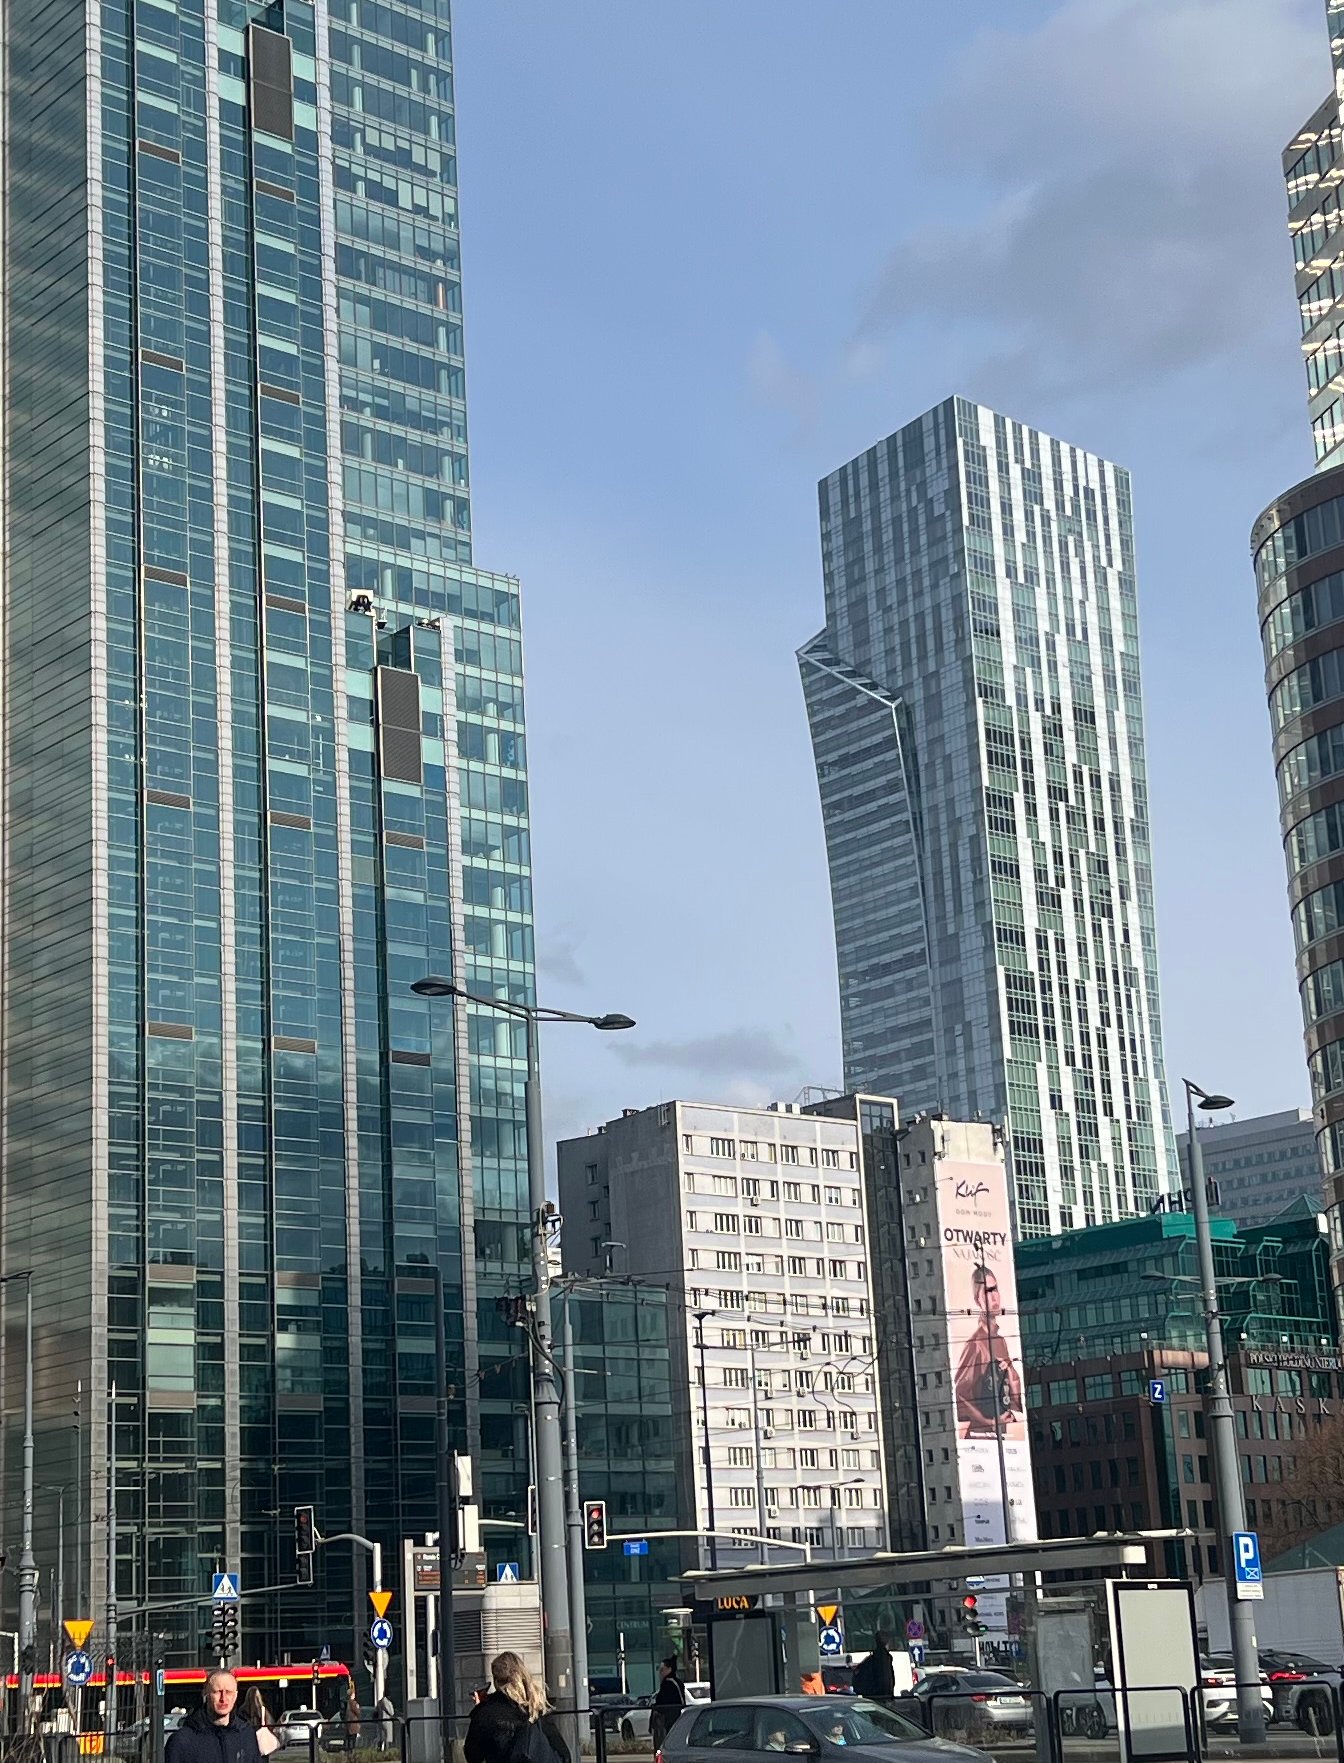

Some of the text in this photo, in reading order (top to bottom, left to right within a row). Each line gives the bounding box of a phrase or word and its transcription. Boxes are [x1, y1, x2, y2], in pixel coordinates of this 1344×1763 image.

[955, 1180, 990, 1208] Klif
[944, 1228, 1006, 1246] OTWARTY
[1154, 1384, 1162, 1398] Z
[1238, 1536, 1254, 1568] P
[718, 1596, 749, 1610] LUCA
